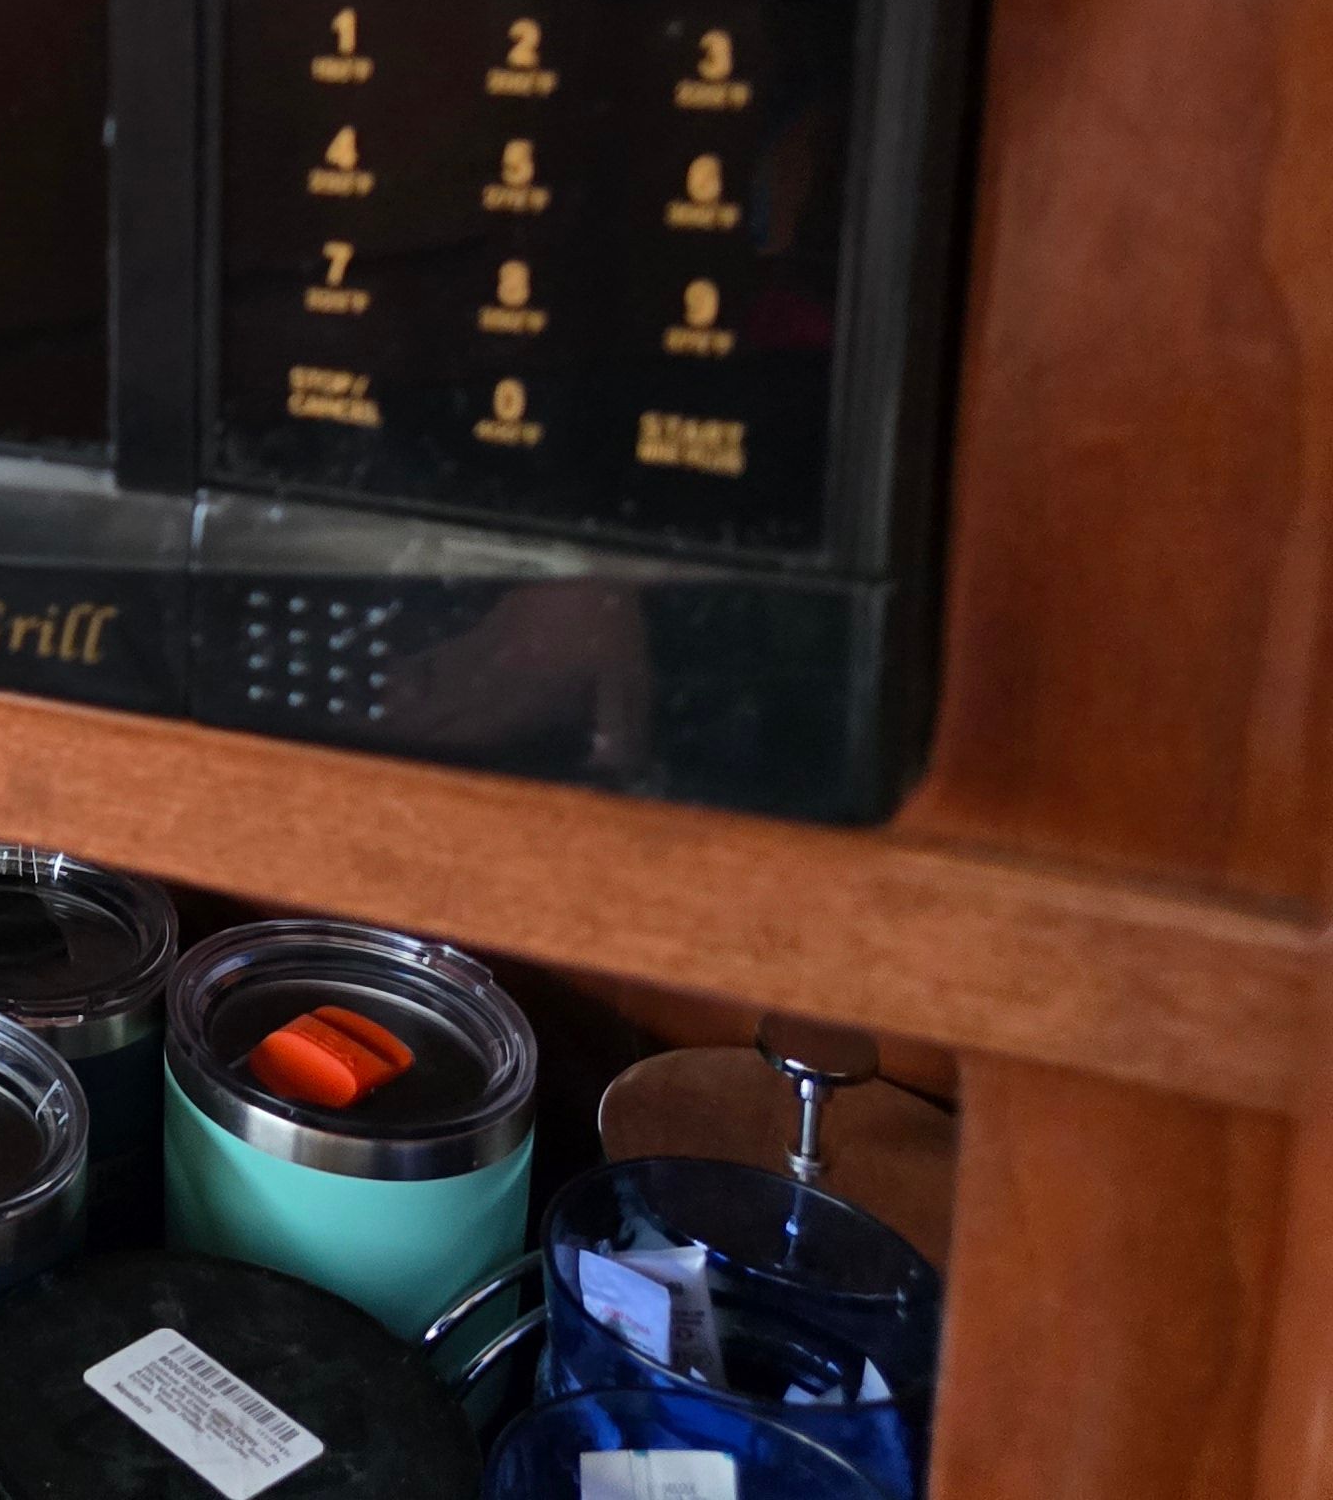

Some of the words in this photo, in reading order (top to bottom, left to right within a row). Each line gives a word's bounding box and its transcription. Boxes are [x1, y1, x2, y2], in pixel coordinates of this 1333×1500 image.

[331, 6, 358, 55] 1
[506, 17, 542, 68] 2
[697, 28, 733, 81] 3
[324, 124, 359, 171] 4
[321, 240, 354, 286] 7
[492, 376, 527, 422] 0
